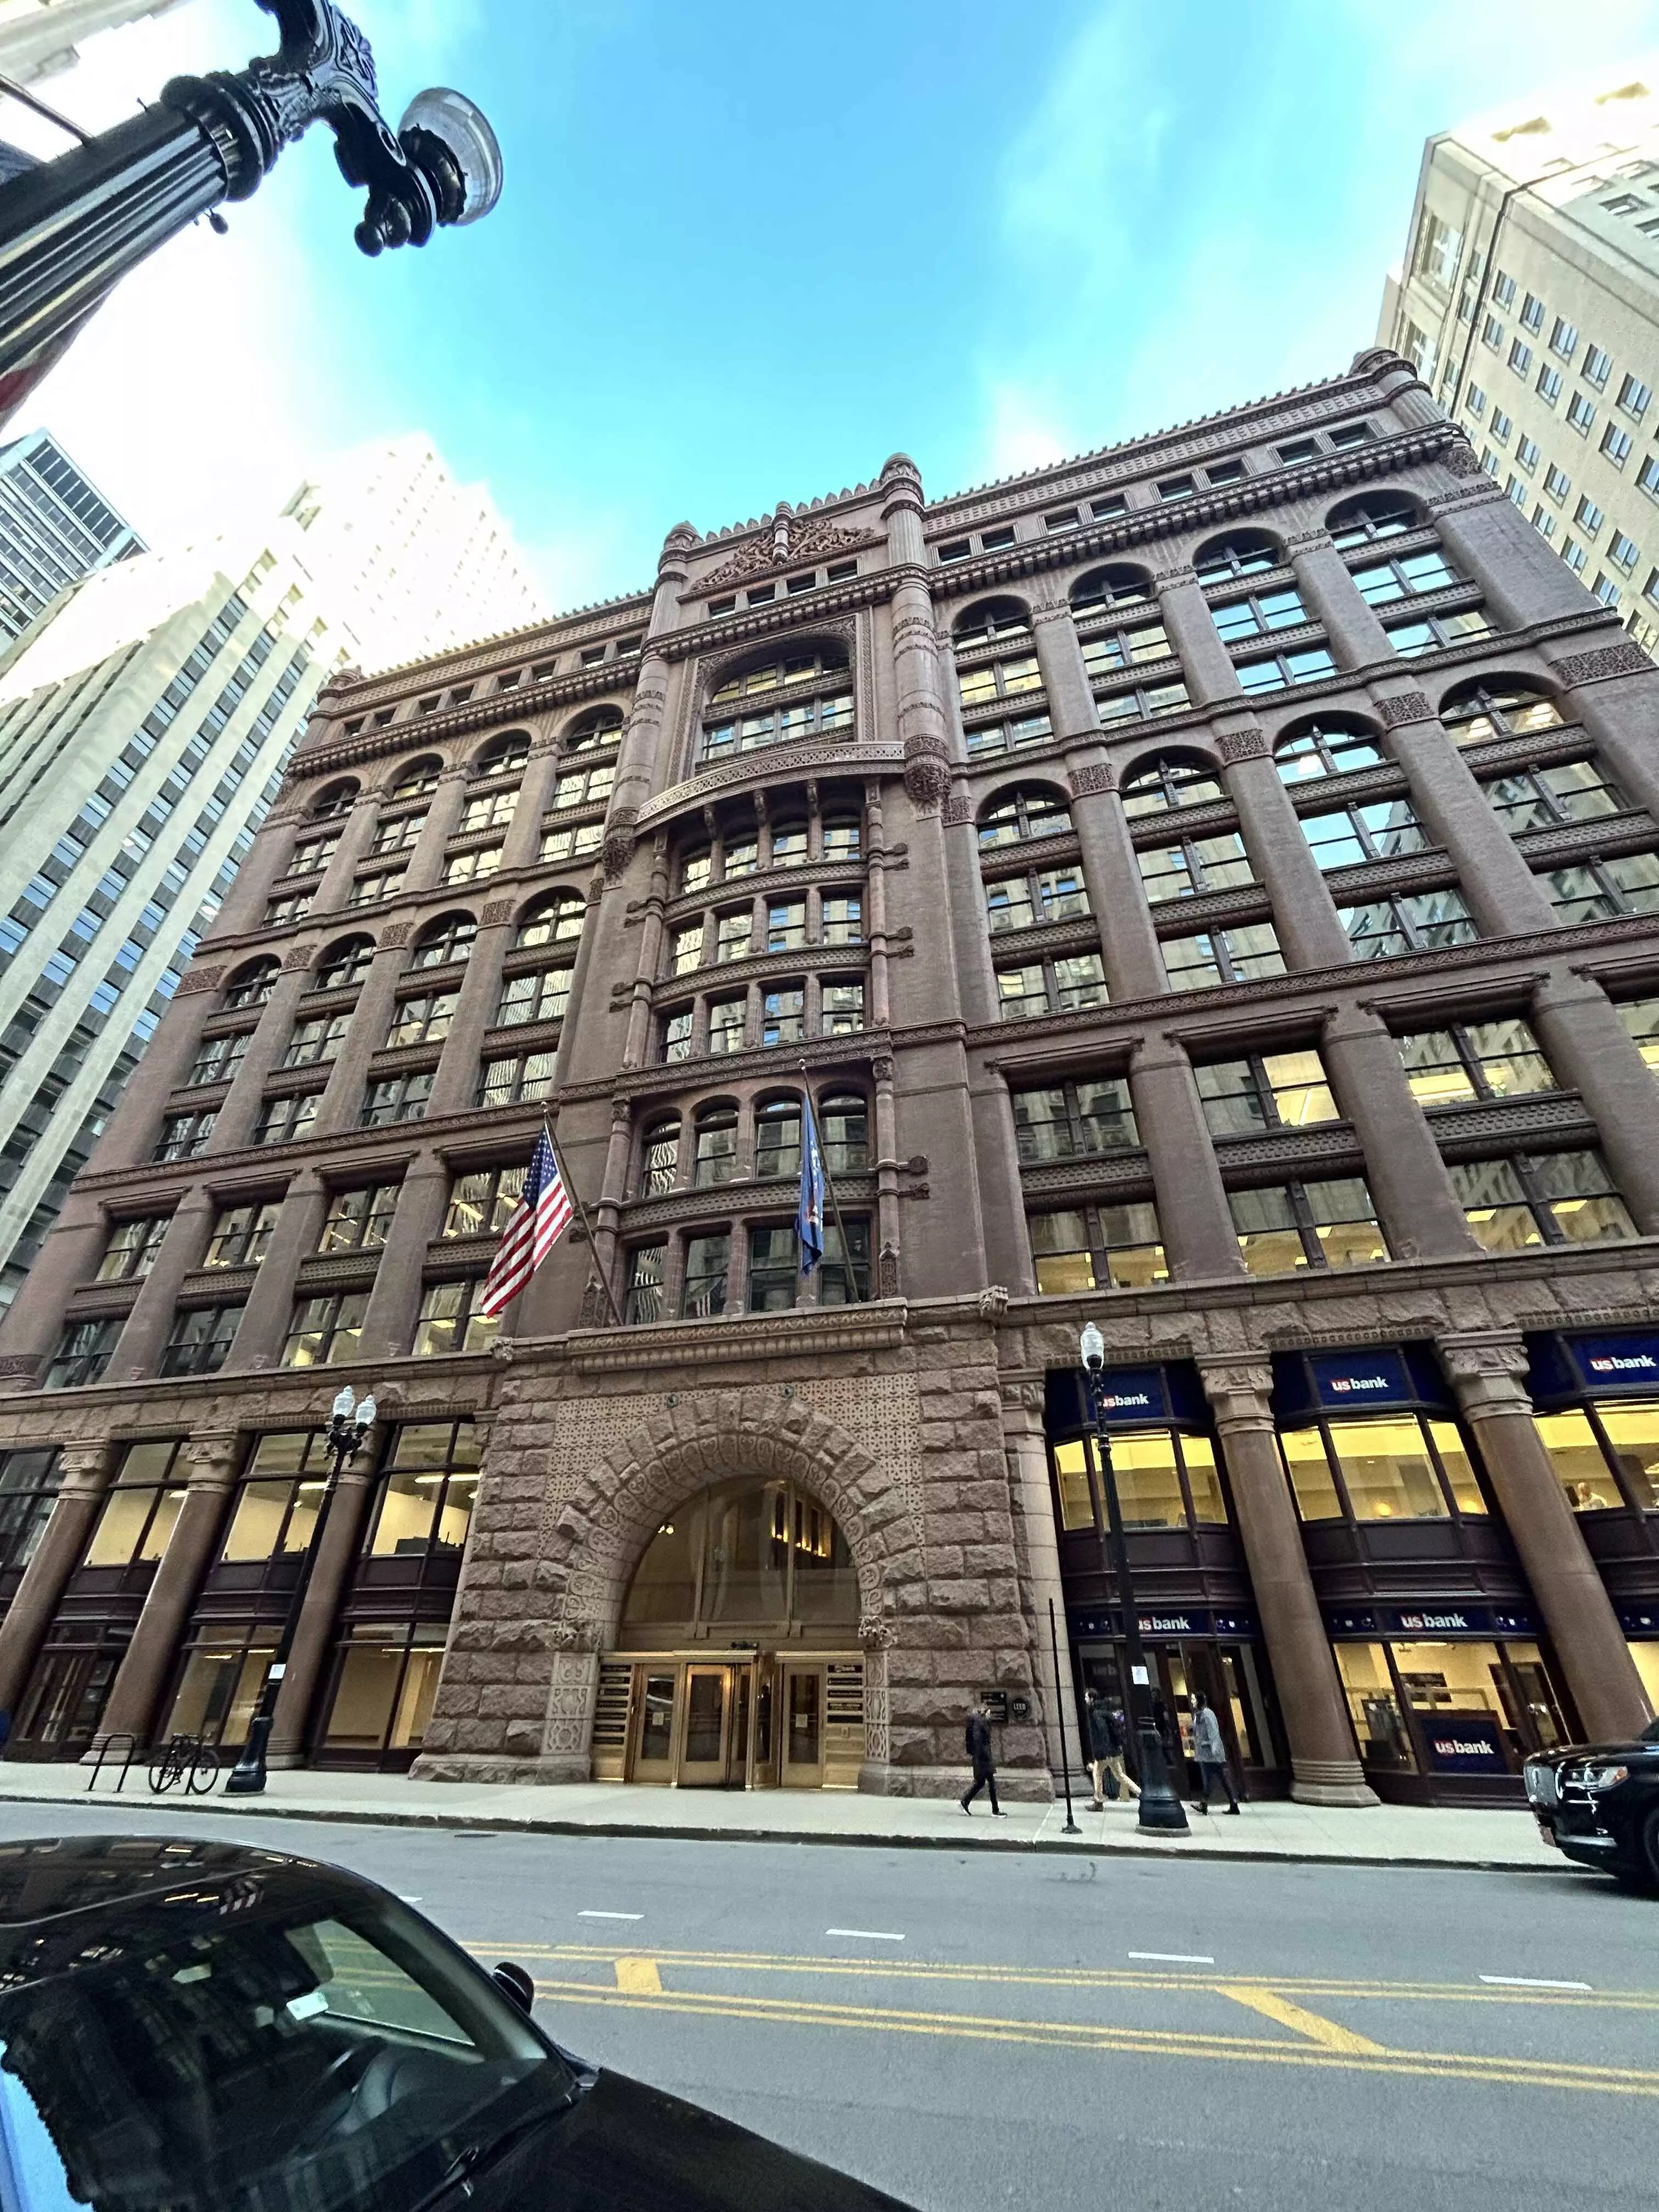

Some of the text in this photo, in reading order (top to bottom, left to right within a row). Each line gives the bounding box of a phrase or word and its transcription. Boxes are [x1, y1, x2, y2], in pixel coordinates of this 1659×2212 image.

[1591, 1355, 1657, 1370] usbank
[1331, 1376, 1390, 1391] usbank
[1435, 1739, 1494, 1754] usbank
